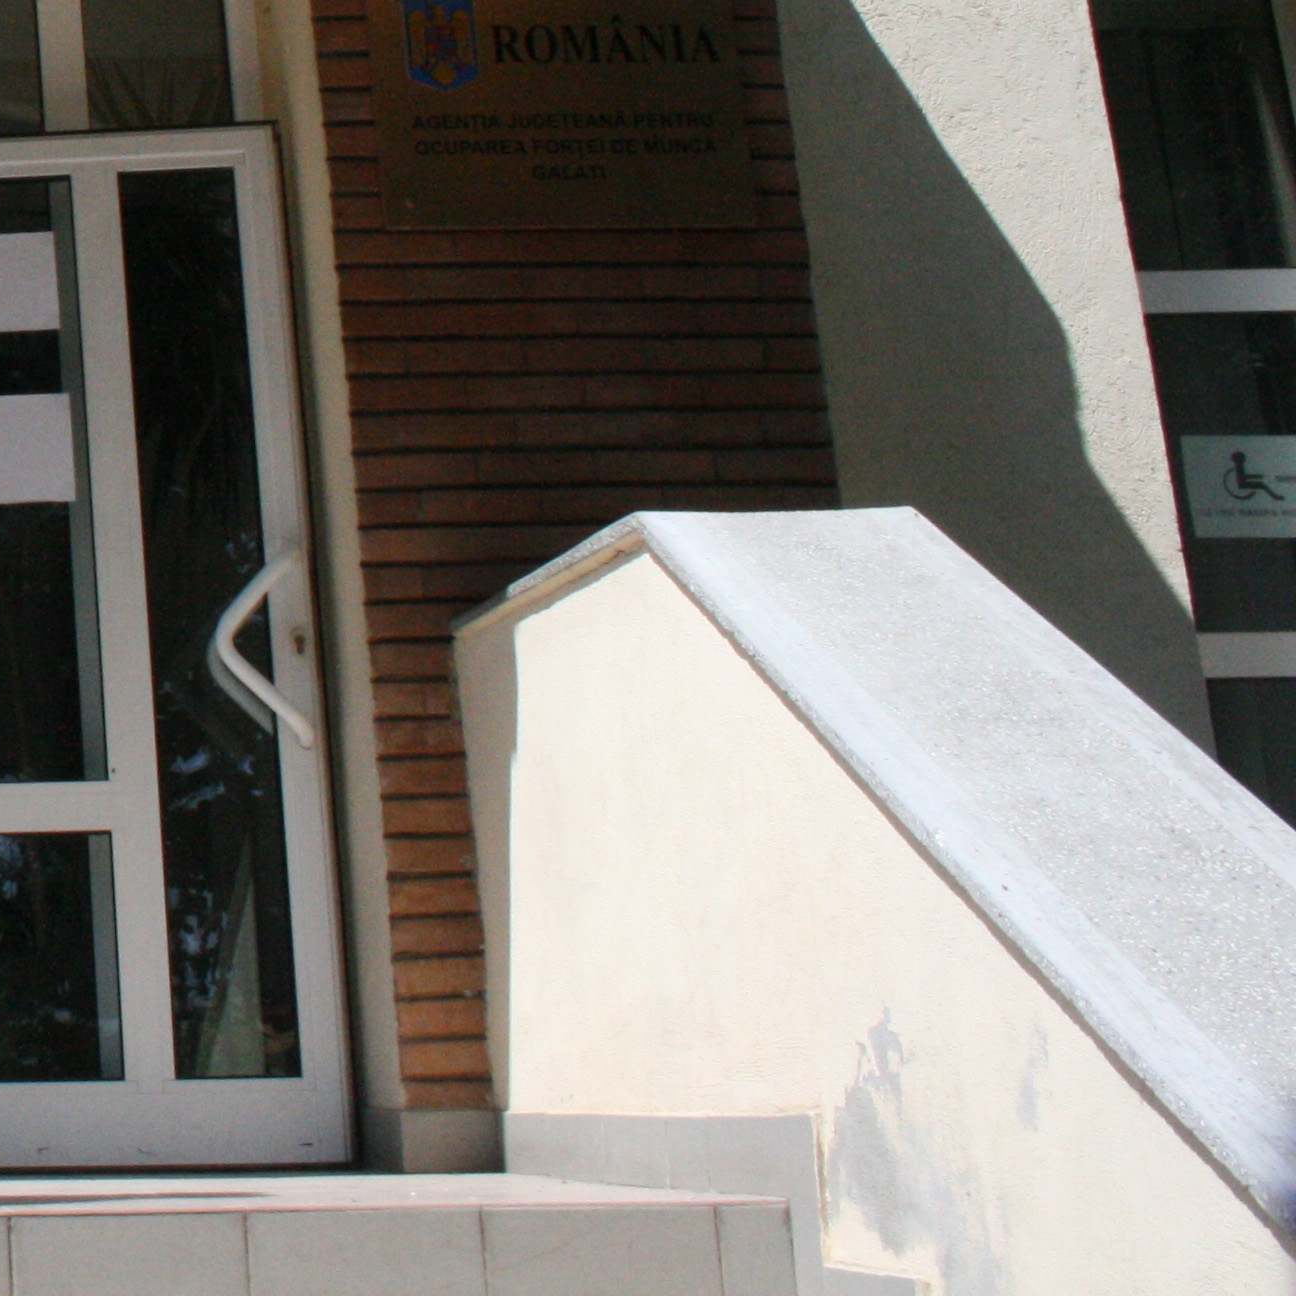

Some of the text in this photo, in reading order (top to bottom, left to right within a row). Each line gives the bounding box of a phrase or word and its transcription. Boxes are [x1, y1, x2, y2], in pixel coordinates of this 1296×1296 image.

[491, 14, 722, 64] ROMÂNIA
[634, 113, 715, 130] PENTRU
[413, 140, 526, 156] OCUPAREA
[611, 139, 637, 154] DE
